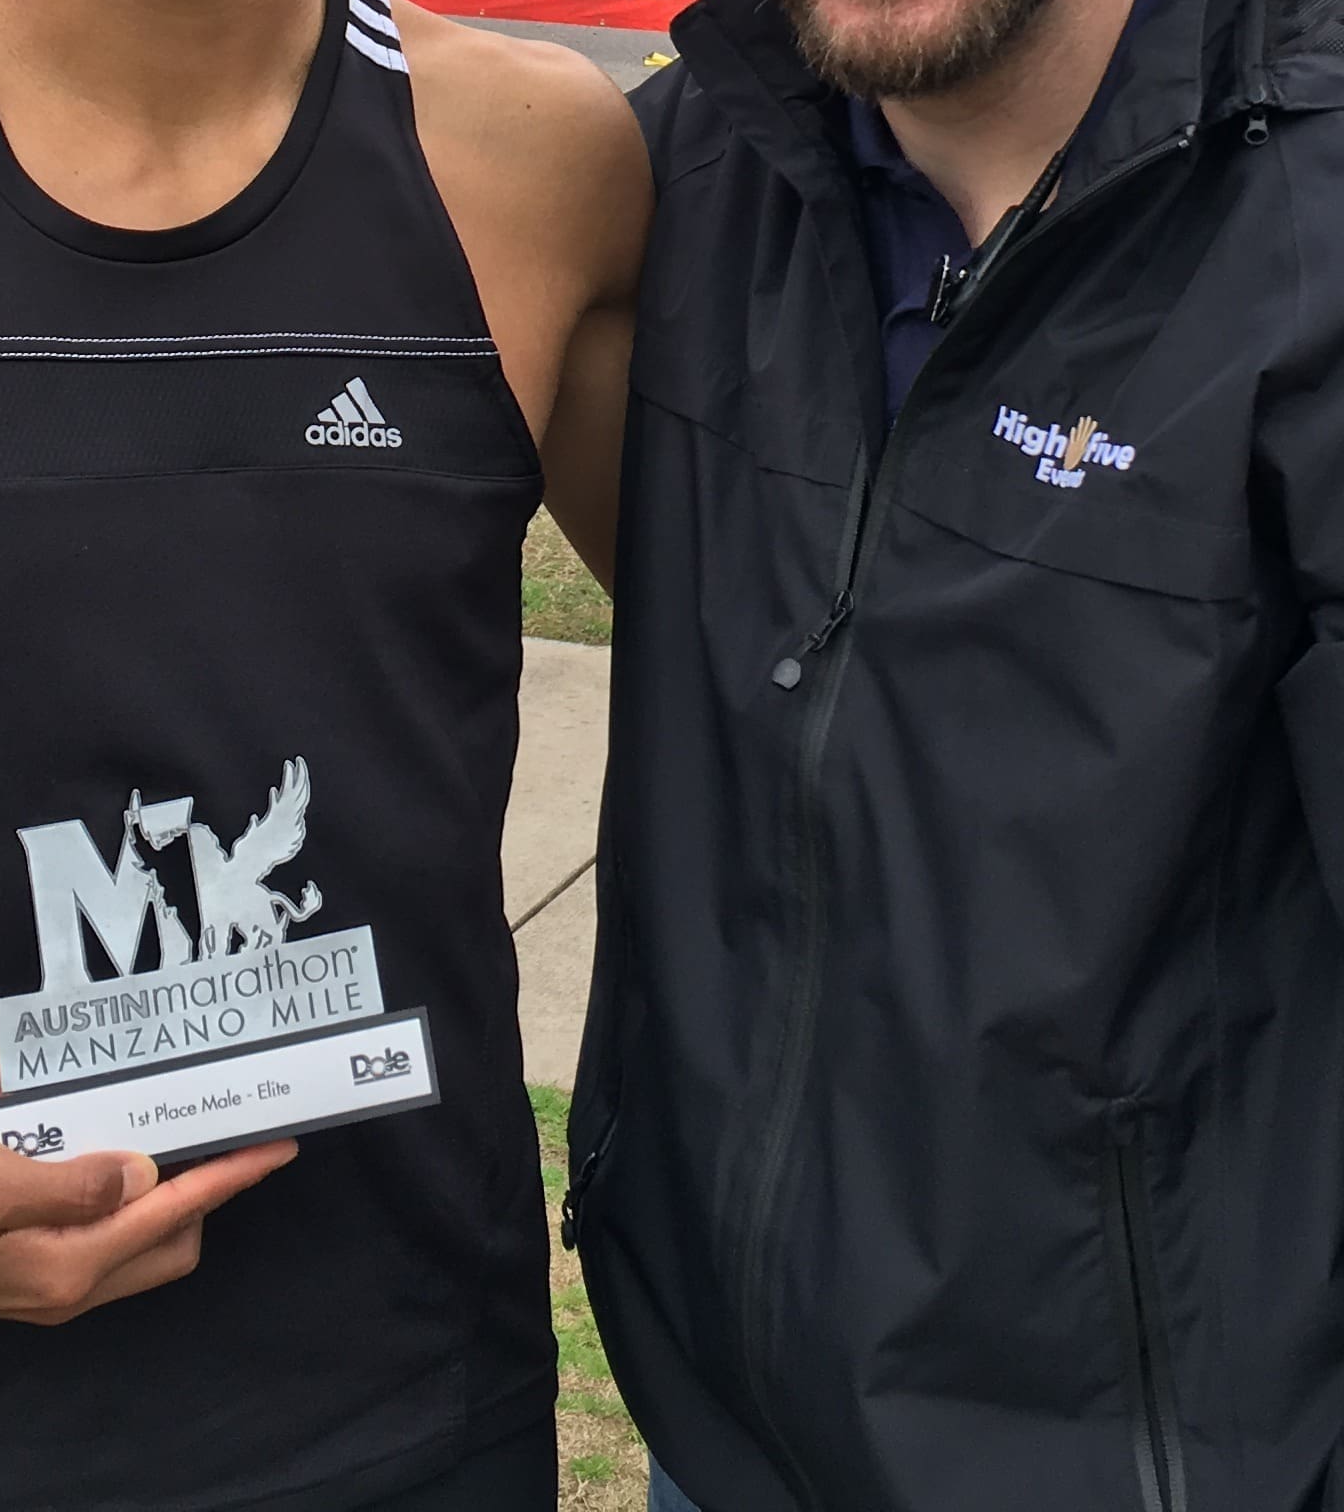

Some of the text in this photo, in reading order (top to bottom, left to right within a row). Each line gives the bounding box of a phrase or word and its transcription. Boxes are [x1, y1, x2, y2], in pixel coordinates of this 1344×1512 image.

[305, 420, 403, 448] adidas
[993, 405, 1069, 459] High
[17, 982, 363, 1081] MANZANO MILE
[350, 1047, 411, 1081] Dole
[127, 1110, 150, 1129] 1st
[155, 1102, 197, 1124] Place
[201, 1088, 242, 1113] Male
[256, 1079, 291, 1101] Elite
[1, 1123, 64, 1157] Dole
